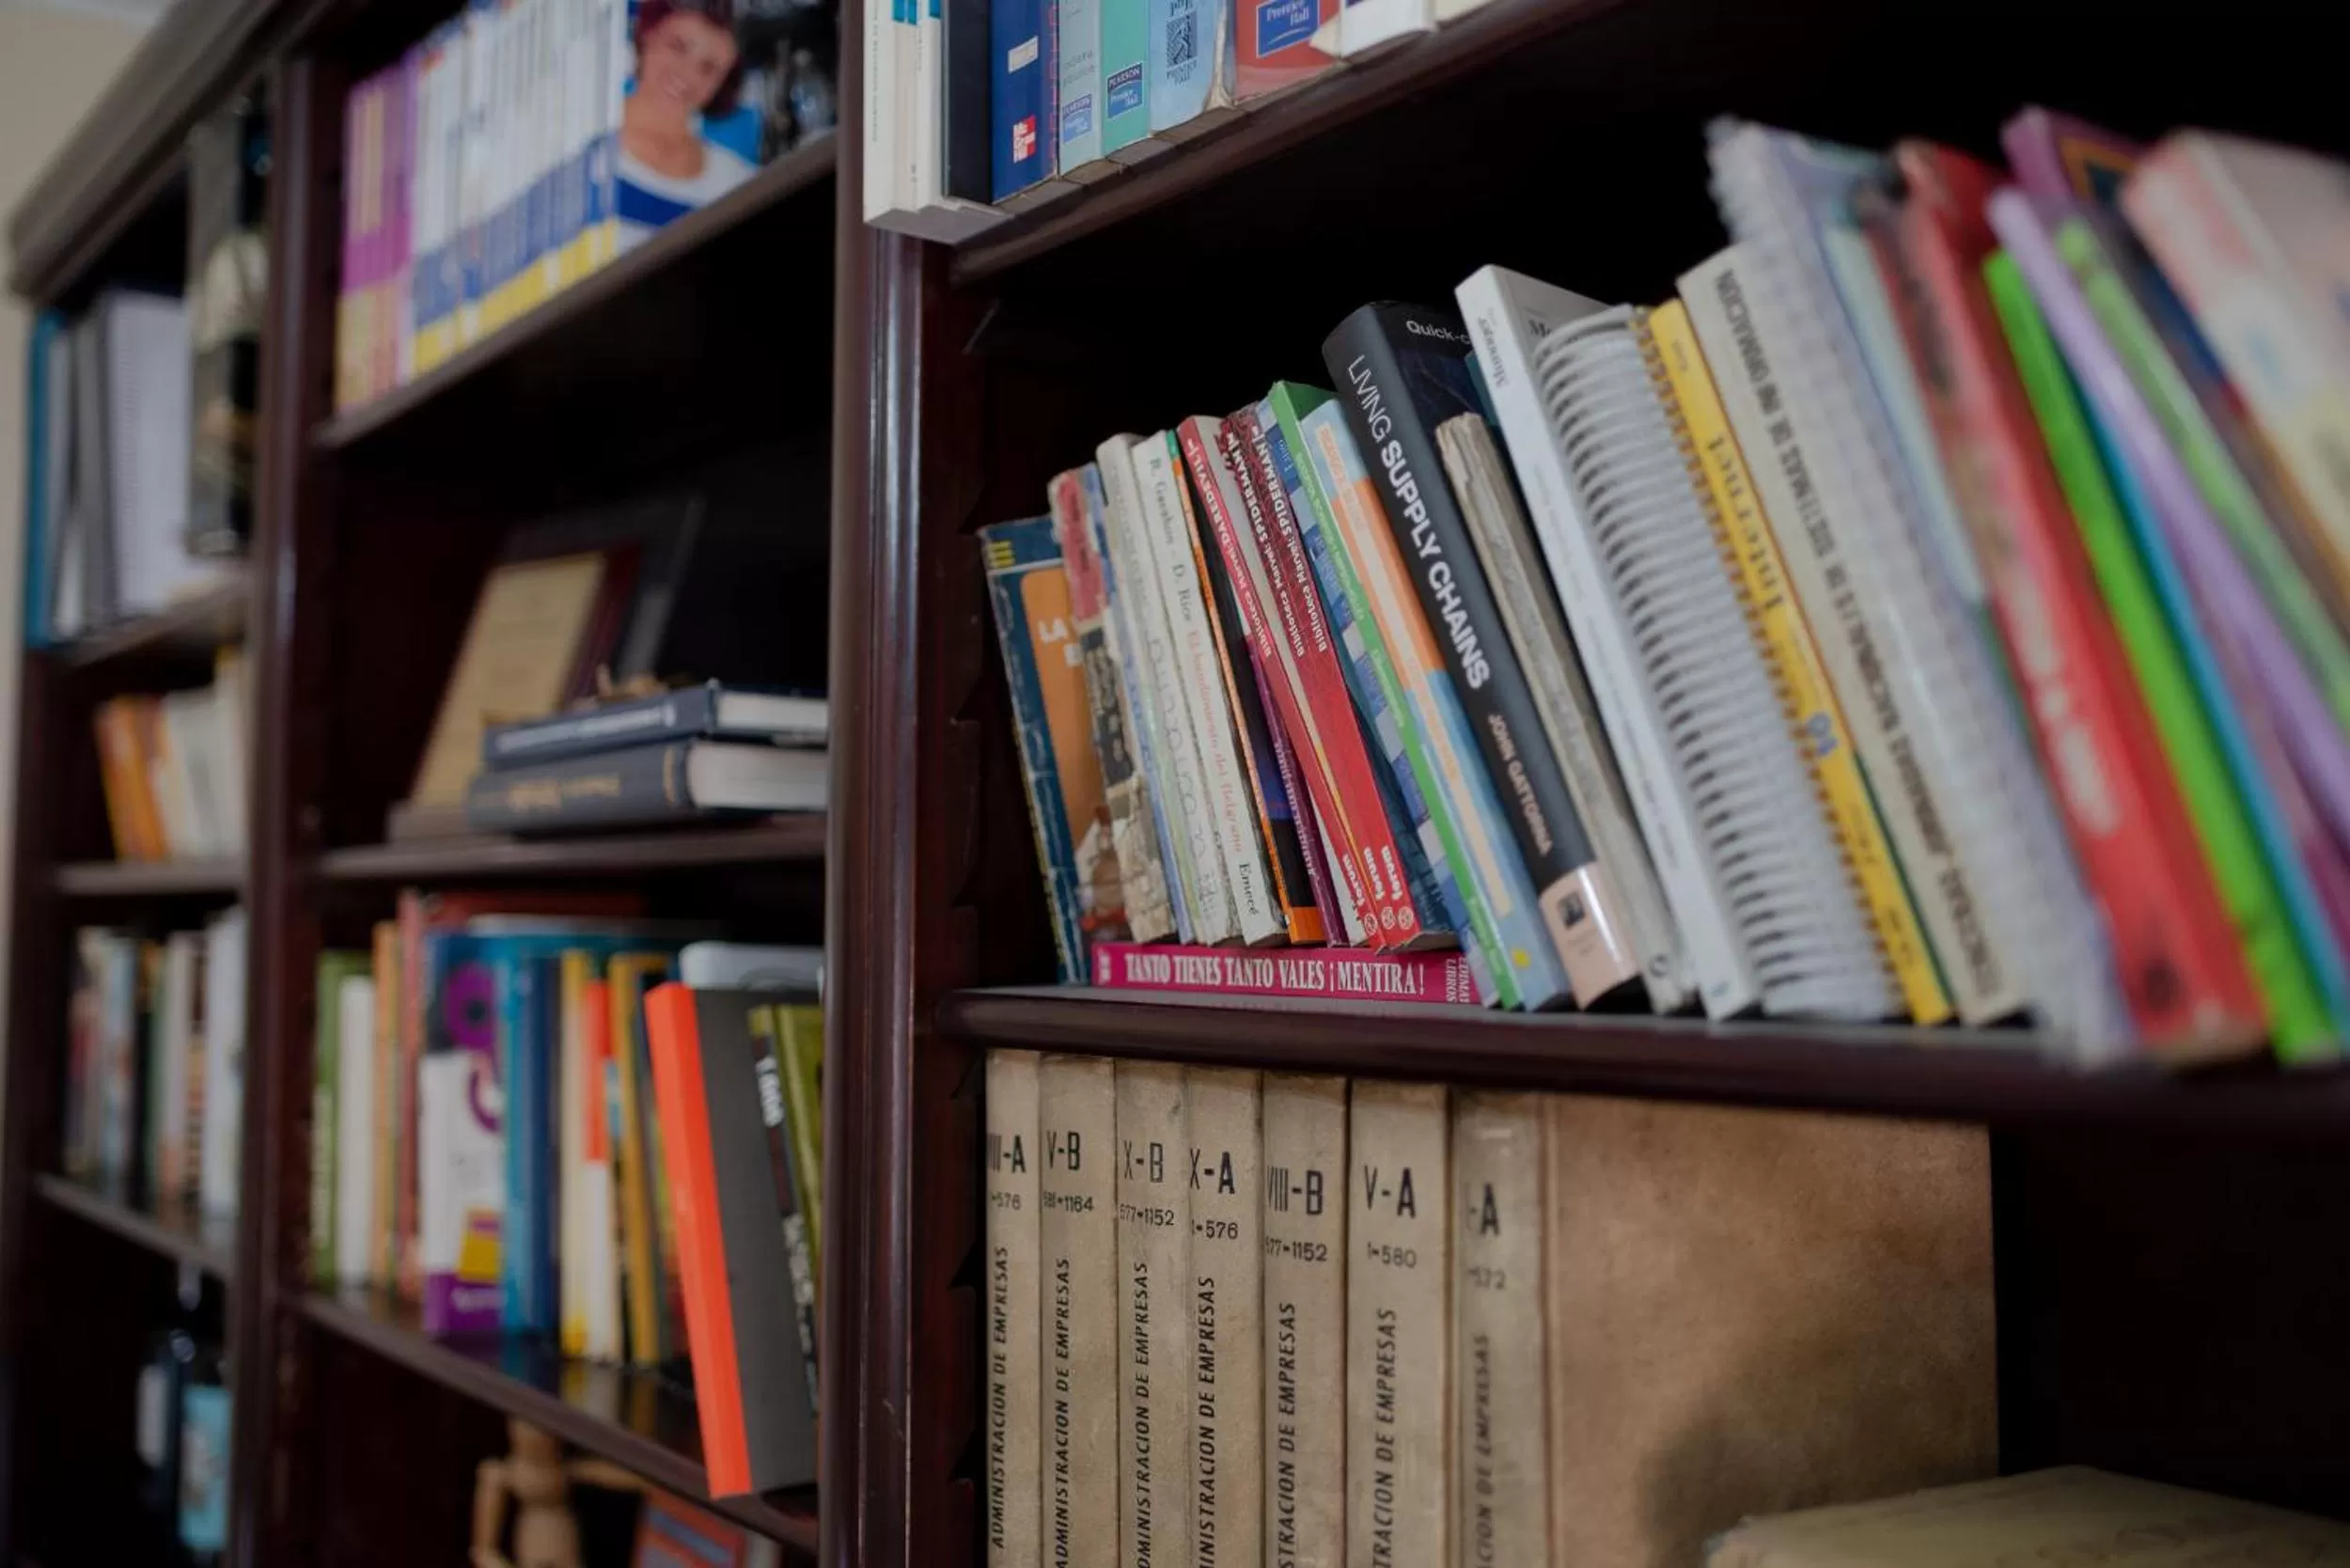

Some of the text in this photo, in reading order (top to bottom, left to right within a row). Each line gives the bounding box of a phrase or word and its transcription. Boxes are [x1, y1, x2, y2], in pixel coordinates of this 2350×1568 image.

[1192, 453, 1230, 542] DAREDEVIL
[1230, 446, 1267, 543] SPIDERMAN
[1253, 440, 1290, 540] SPIDERMAN
[1347, 354, 1392, 443] LIVING
[1381, 439, 1442, 558] SUPPLY
[1427, 561, 1492, 690] CHAINS
[1038, 617, 1069, 644] LA
[1279, 590, 1305, 658] Biblioteca
[1302, 586, 1328, 653] Biblioteca
[1487, 713, 1510, 762] JOHN
[1124, 953, 1171, 984] TANTO
[1173, 953, 1222, 986] TIENES
[1224, 955, 1274, 988] TANTO
[1278, 958, 1325, 991] VALES
[1446, 958, 1457, 1004] LIBROS
[1123, 1140, 1164, 1183] X-B
[1189, 1148, 1235, 1195] X-A
[1364, 1165, 1417, 1219] V-A
[1055, 1258, 1070, 1361] EMPRESAS
[1134, 1262, 1150, 1366] EMPRESAS
[1197, 1277, 1215, 1385] EMPRESAS
[1055, 1366, 1070, 1393] DE
[1135, 1372, 1150, 1400] DE
[1277, 1302, 1295, 1417] EMPRESAS
[1375, 1307, 1398, 1425] EMPRESAS
[991, 1246, 1009, 1549] ADMINISTRACION DE EMPRESAS
[1198, 1390, 1215, 1419] DE
[1277, 1423, 1295, 1453] DE
[1374, 1433, 1395, 1464] DE
